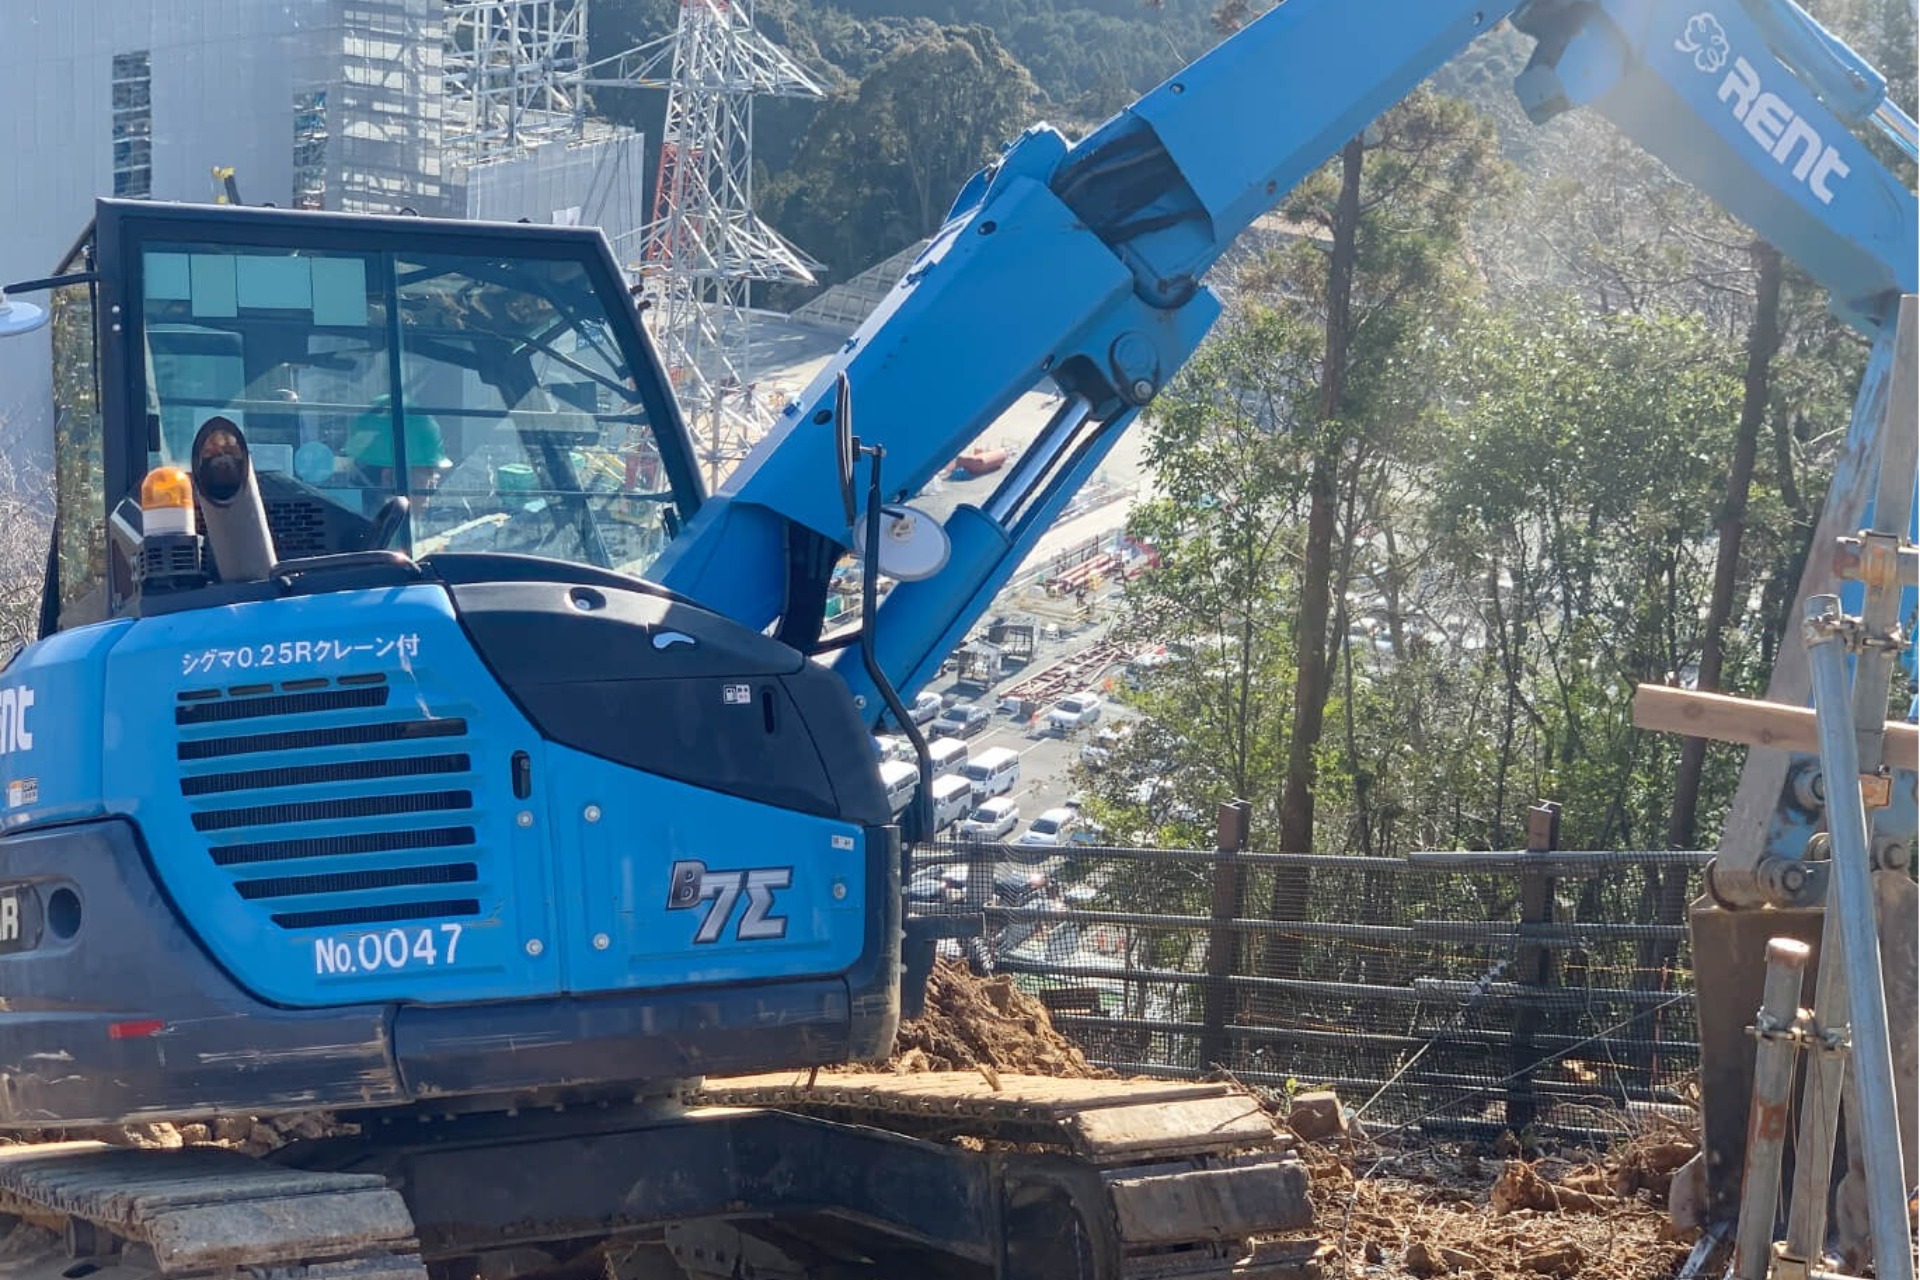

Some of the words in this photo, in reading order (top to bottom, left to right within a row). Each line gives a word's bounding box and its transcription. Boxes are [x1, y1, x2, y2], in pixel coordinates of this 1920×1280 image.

[182, 633, 420, 675] シグマ0.25Rクレーン付
[315, 923, 462, 974] No.0047
